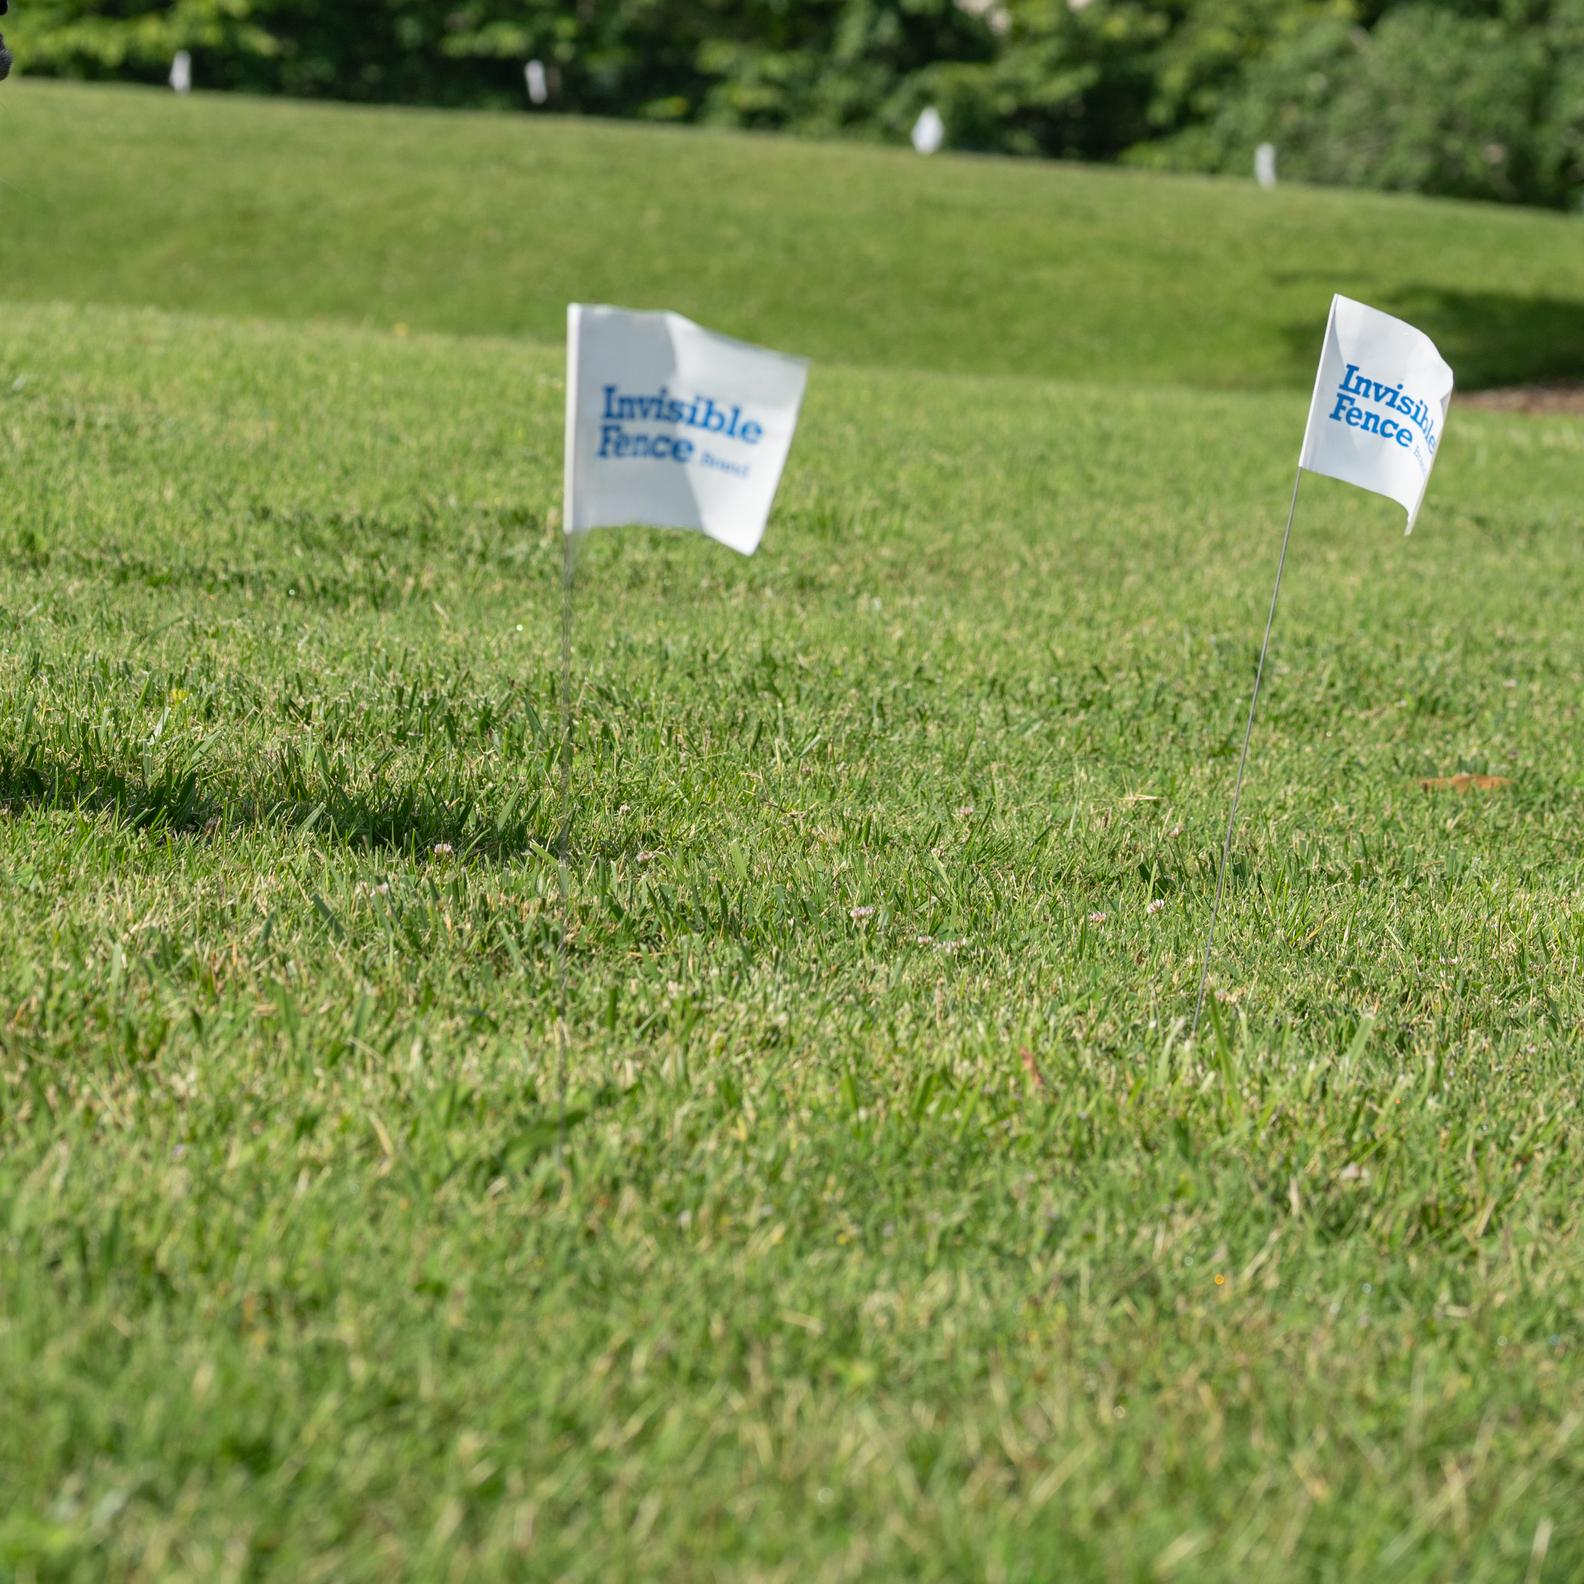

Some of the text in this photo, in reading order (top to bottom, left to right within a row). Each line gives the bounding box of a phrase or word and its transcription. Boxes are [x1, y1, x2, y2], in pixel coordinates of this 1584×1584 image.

[602, 385, 763, 444] Invisible
[1330, 394, 1413, 447] Fence
[1339, 365, 1436, 454] Invisible
[597, 425, 695, 463] Fence
